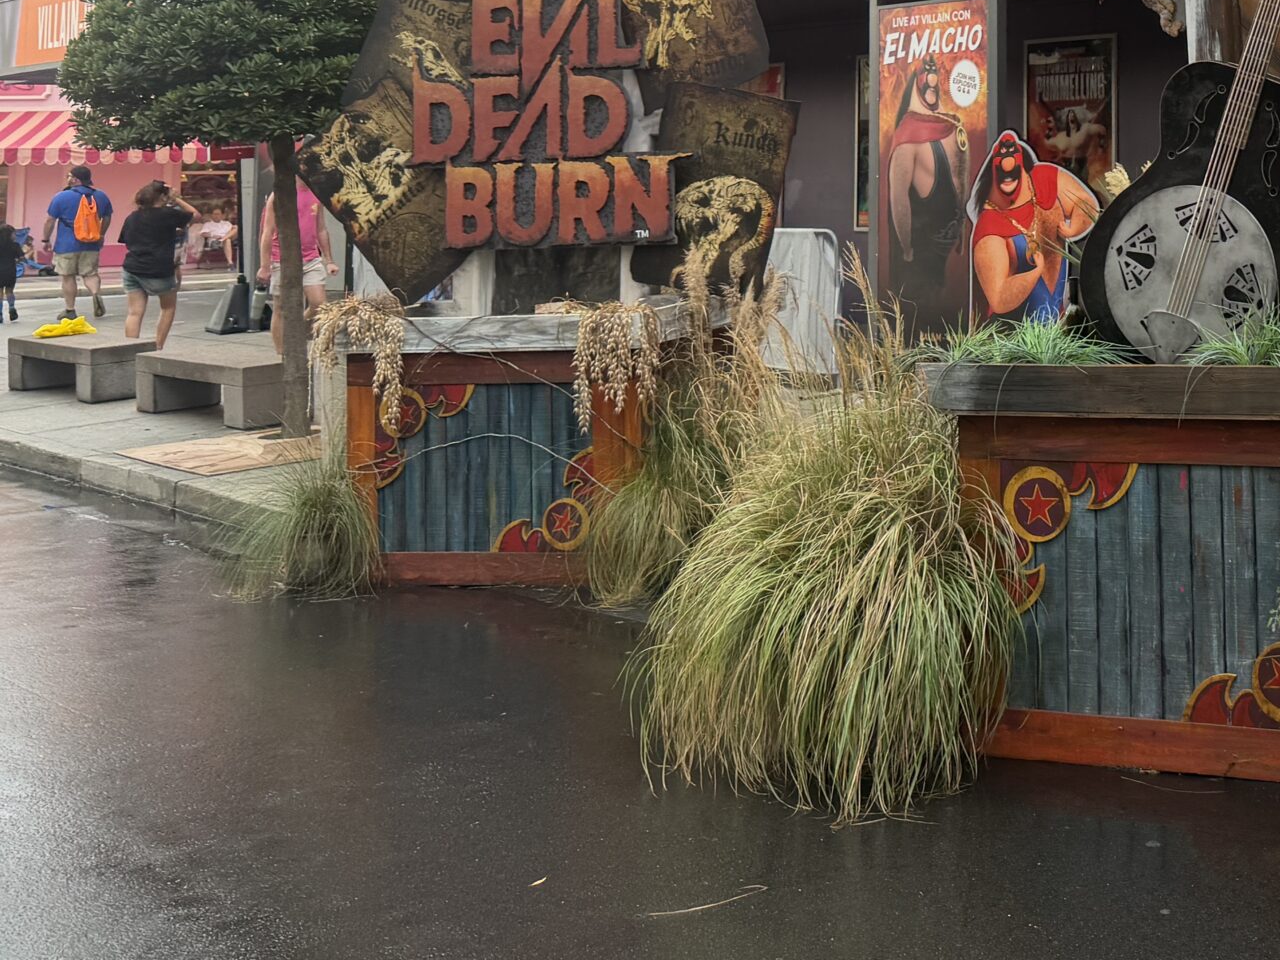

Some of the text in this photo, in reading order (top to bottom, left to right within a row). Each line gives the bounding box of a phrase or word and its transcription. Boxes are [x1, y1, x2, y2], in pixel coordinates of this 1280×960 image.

[883, 24, 982, 65] EL MACHO
[892, 10, 971, 28] LIVE AT VILLAIN CON
[406, 53, 630, 166] DEAD
[445, 152, 693, 247] BURN TM
